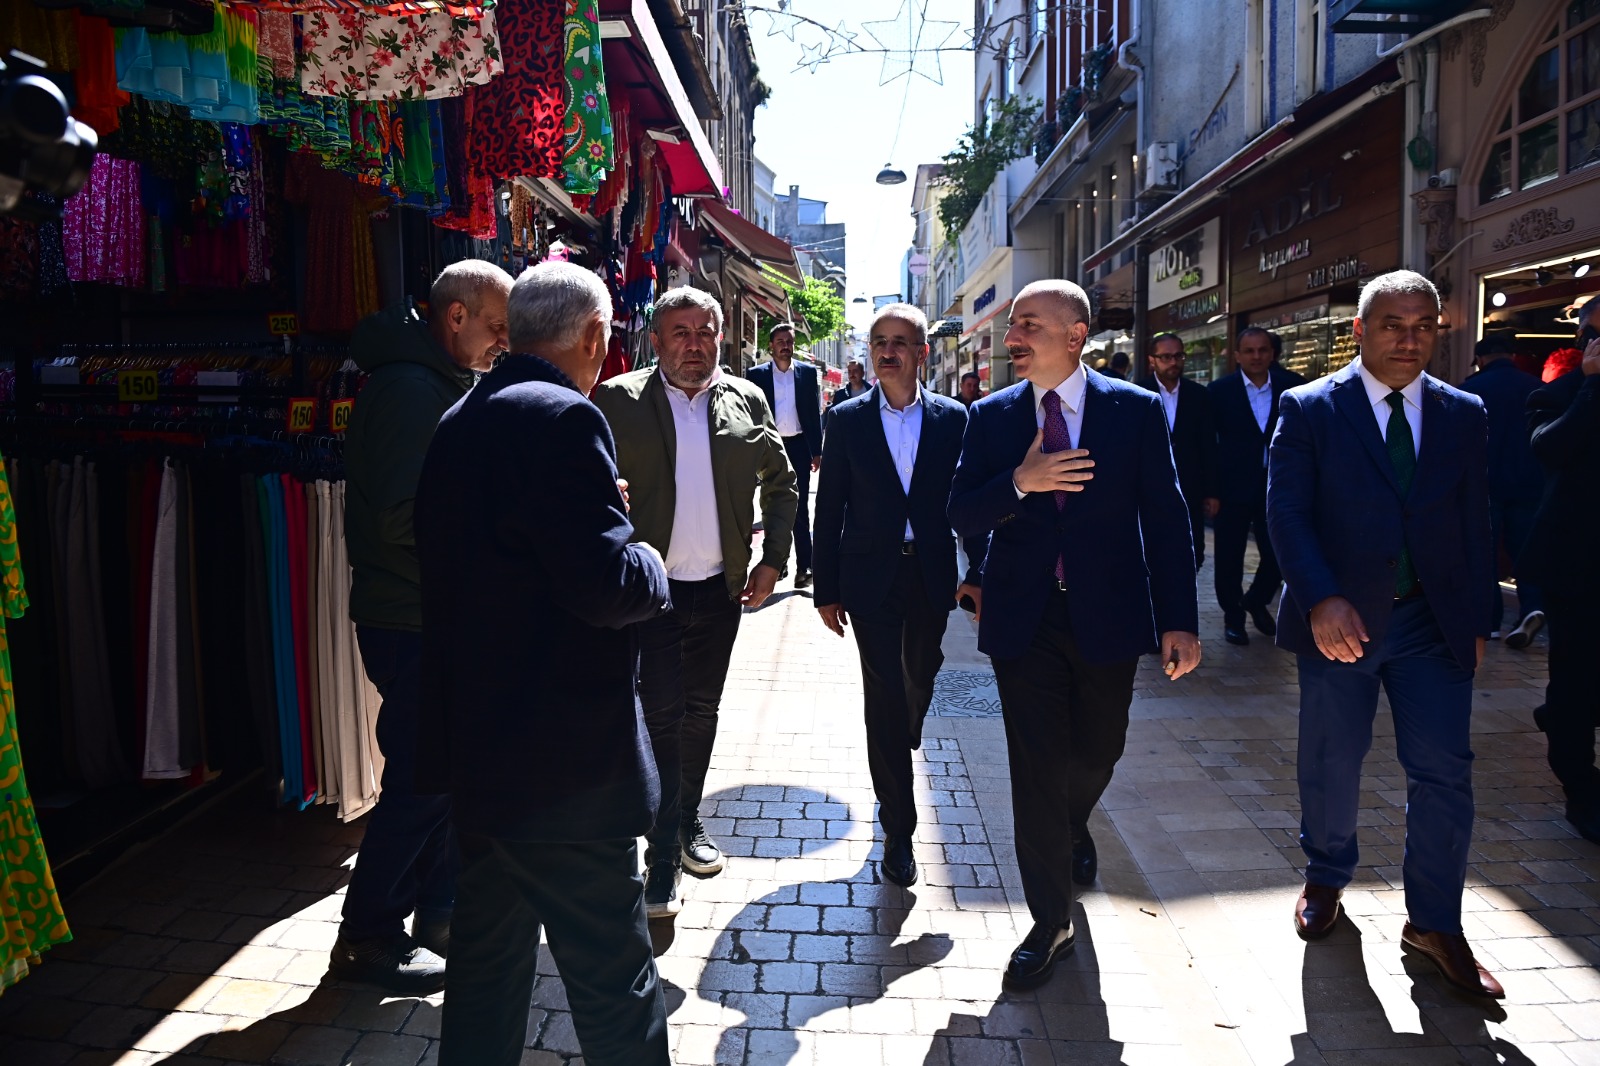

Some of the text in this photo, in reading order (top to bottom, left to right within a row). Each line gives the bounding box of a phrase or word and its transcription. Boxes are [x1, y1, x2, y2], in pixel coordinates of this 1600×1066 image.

[271, 317, 296, 332] 250
[122, 375, 156, 396] 150
[292, 406, 312, 427] 150
[335, 405, 350, 427] 60
